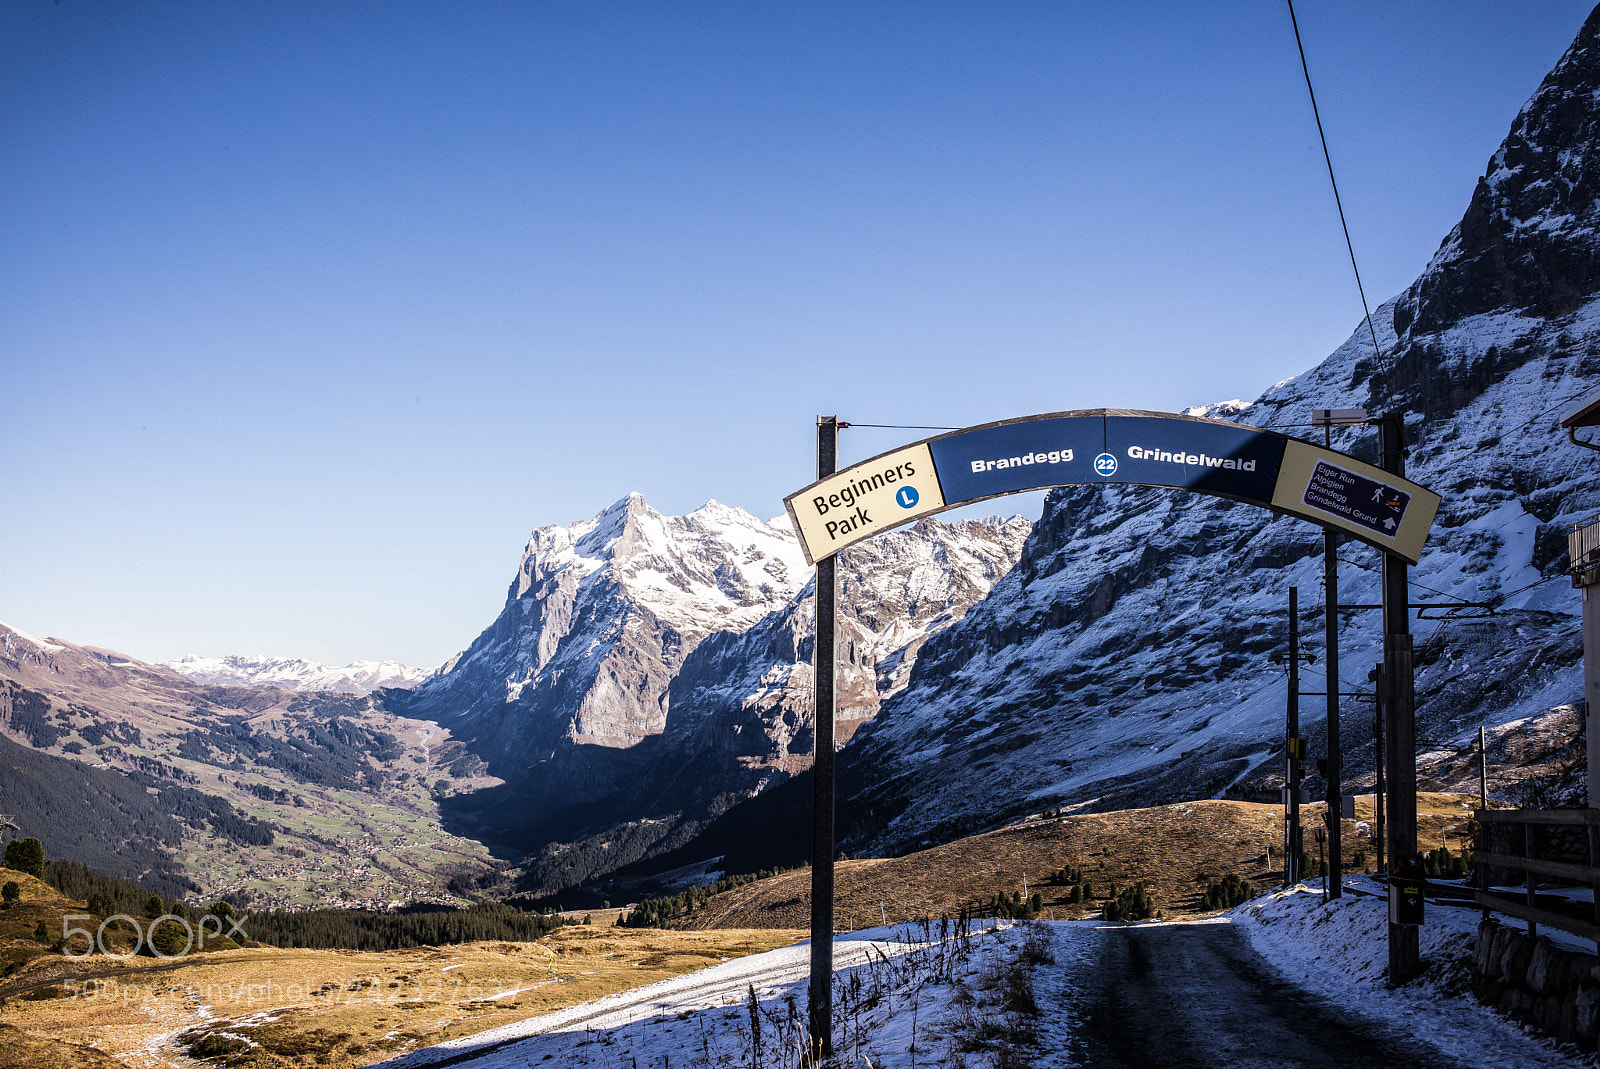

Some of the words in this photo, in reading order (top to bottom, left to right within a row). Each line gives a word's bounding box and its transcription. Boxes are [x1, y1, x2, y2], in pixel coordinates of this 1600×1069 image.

[971, 449, 1074, 473] Brandegg
[1097, 459, 1115, 470] 22
[1127, 445, 1257, 472] Grindelwald
[1313, 474, 1344, 491] Alpiglen
[1317, 465, 1338, 477] Eiger
[1339, 473, 1355, 484] Run
[813, 461, 916, 515] Beginners
[900, 490, 914, 505] L
[1310, 482, 1347, 503] Brandegg
[1307, 491, 1352, 514] Grindelwald
[1352, 509, 1378, 524] Grund
[825, 506, 873, 540] Park
